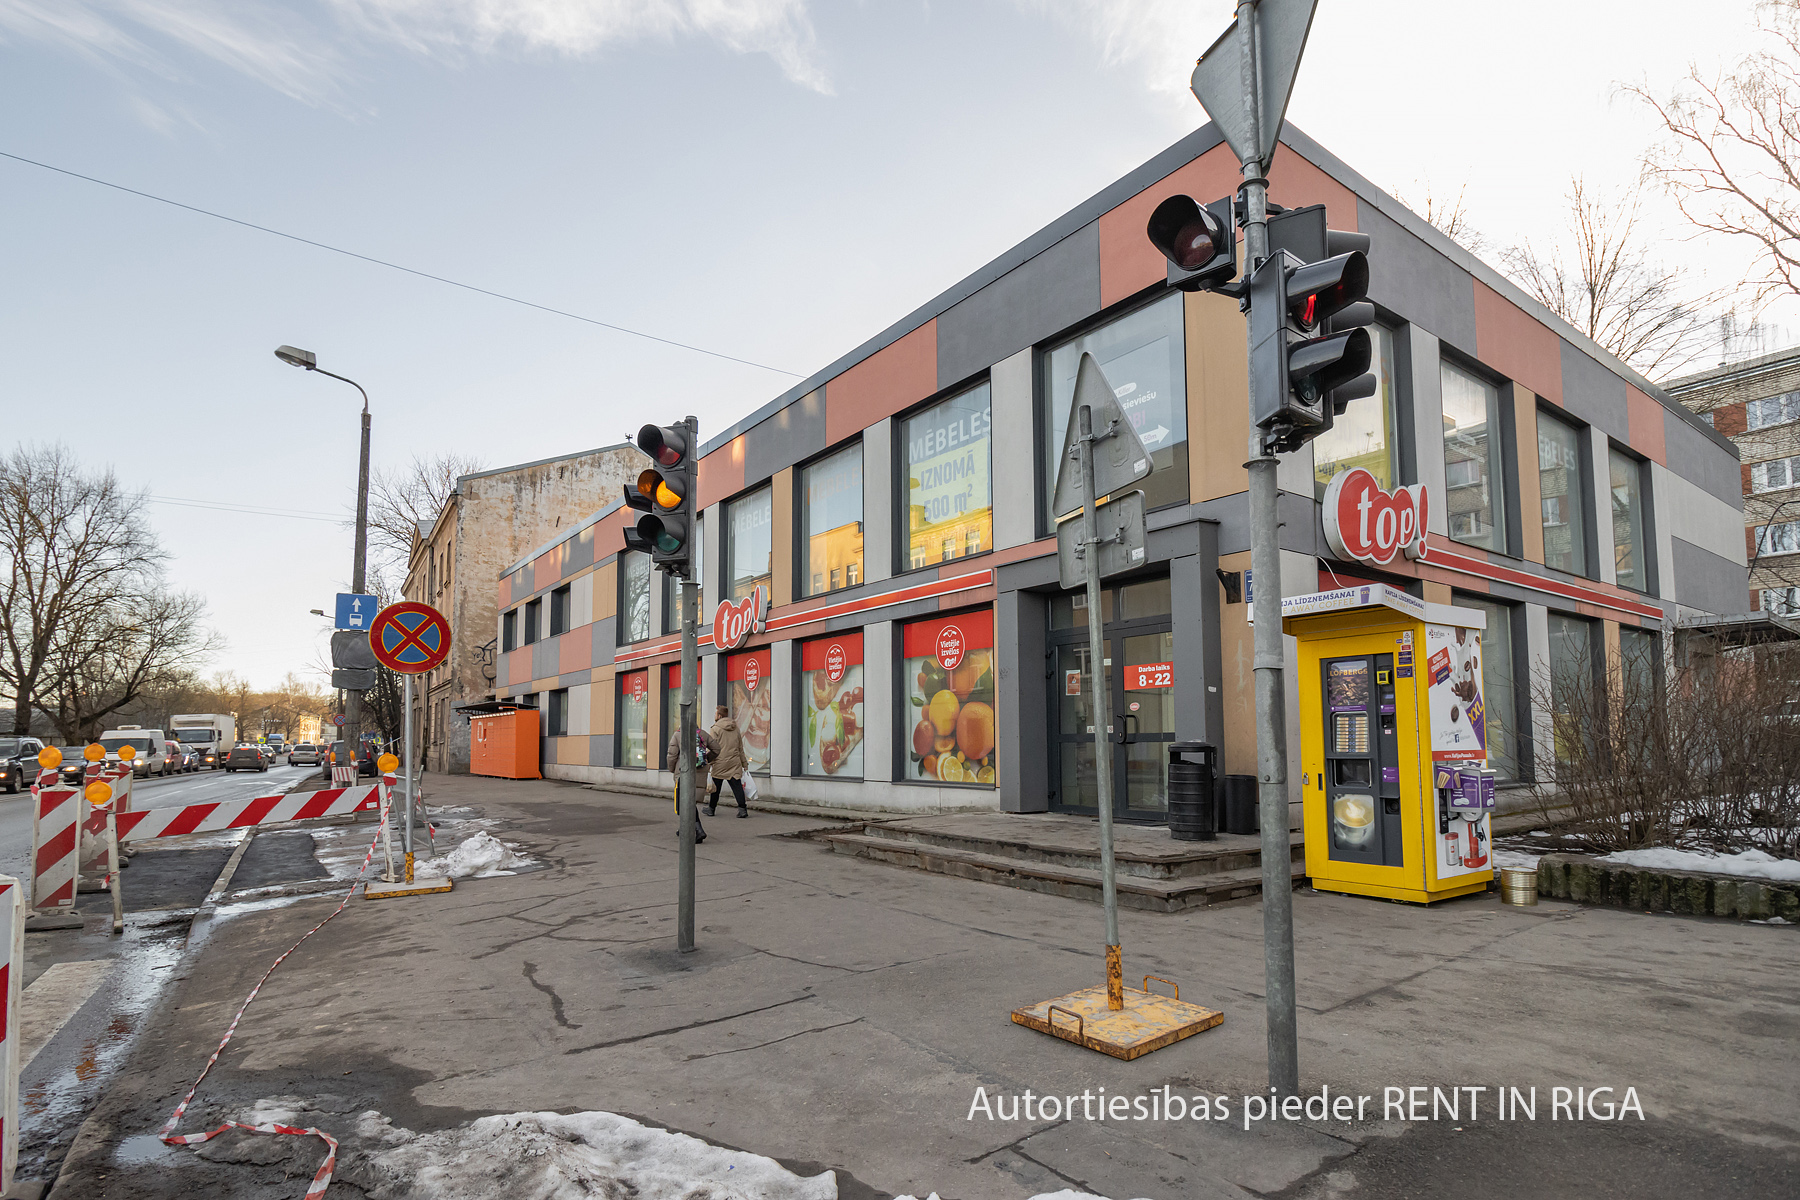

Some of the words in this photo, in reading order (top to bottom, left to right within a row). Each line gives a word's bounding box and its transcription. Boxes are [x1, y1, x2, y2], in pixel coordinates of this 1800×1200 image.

[1122, 391, 1157, 410] sieviešu
[909, 406, 991, 464] MĒBELES
[920, 449, 976, 492] IZNOMĀ
[924, 494, 950, 522] 500
[1290, 603, 1316, 613] AWAY
[1318, 597, 1355, 609] COFFEE
[1408, 605, 1424, 616] COFFEE
[1138, 665, 1155, 673] Darba
[1468, 701, 1484, 725] XXL
